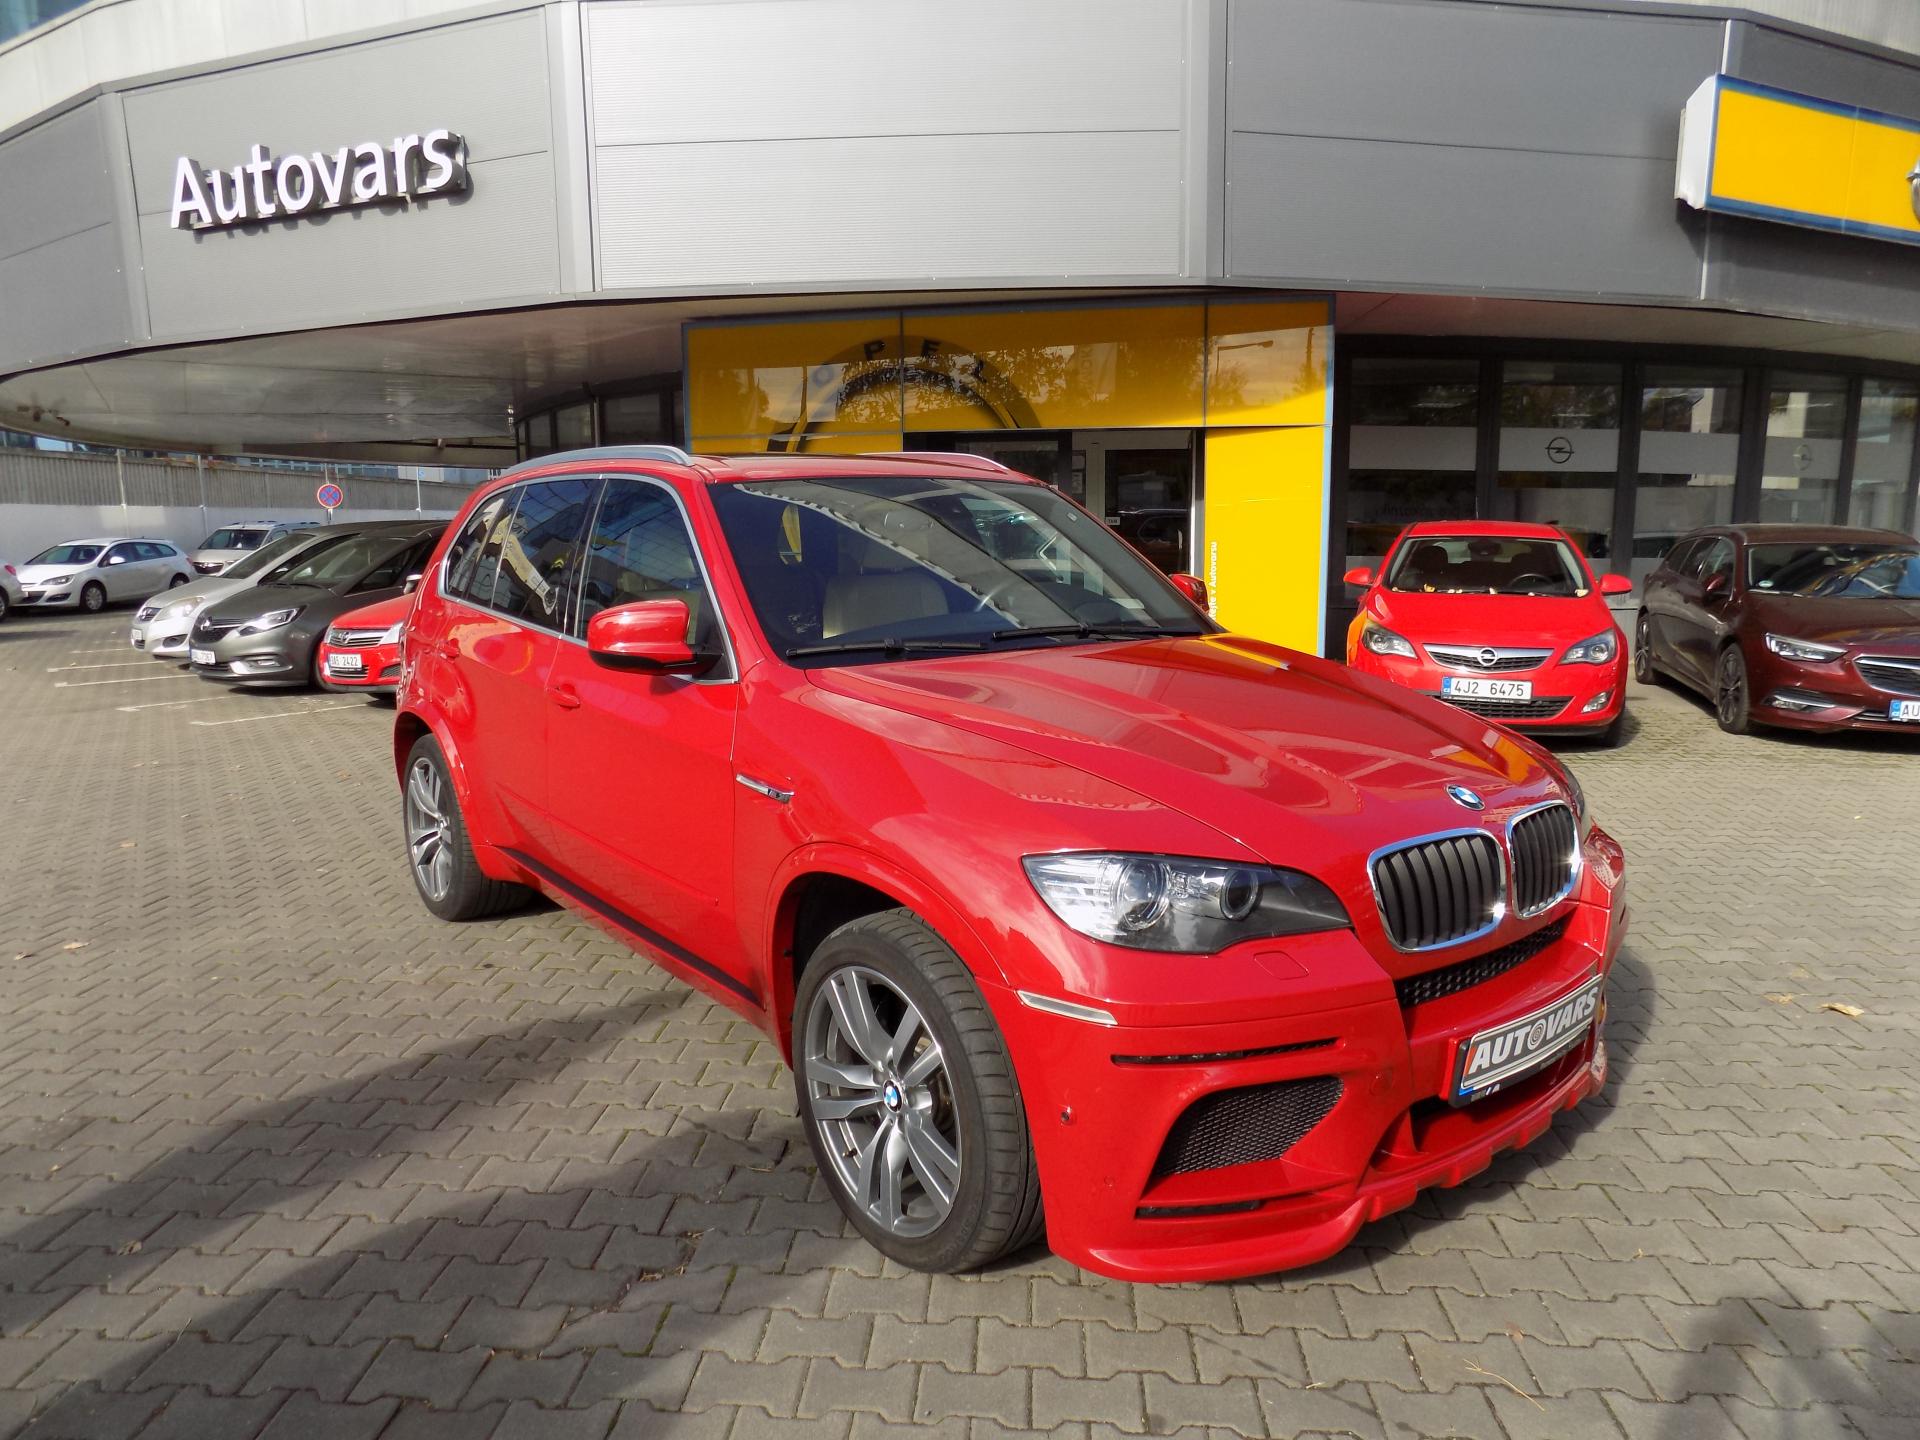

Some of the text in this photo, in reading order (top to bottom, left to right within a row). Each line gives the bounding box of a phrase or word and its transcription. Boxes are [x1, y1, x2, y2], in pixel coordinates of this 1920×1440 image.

[170, 129, 454, 229] Autovars
[1209, 541, 1217, 588] Autovarsu
[1454, 680, 1479, 694] 4J2
[1490, 682, 1524, 697] 6475
[1467, 986, 1599, 1074] AUTOVARS
